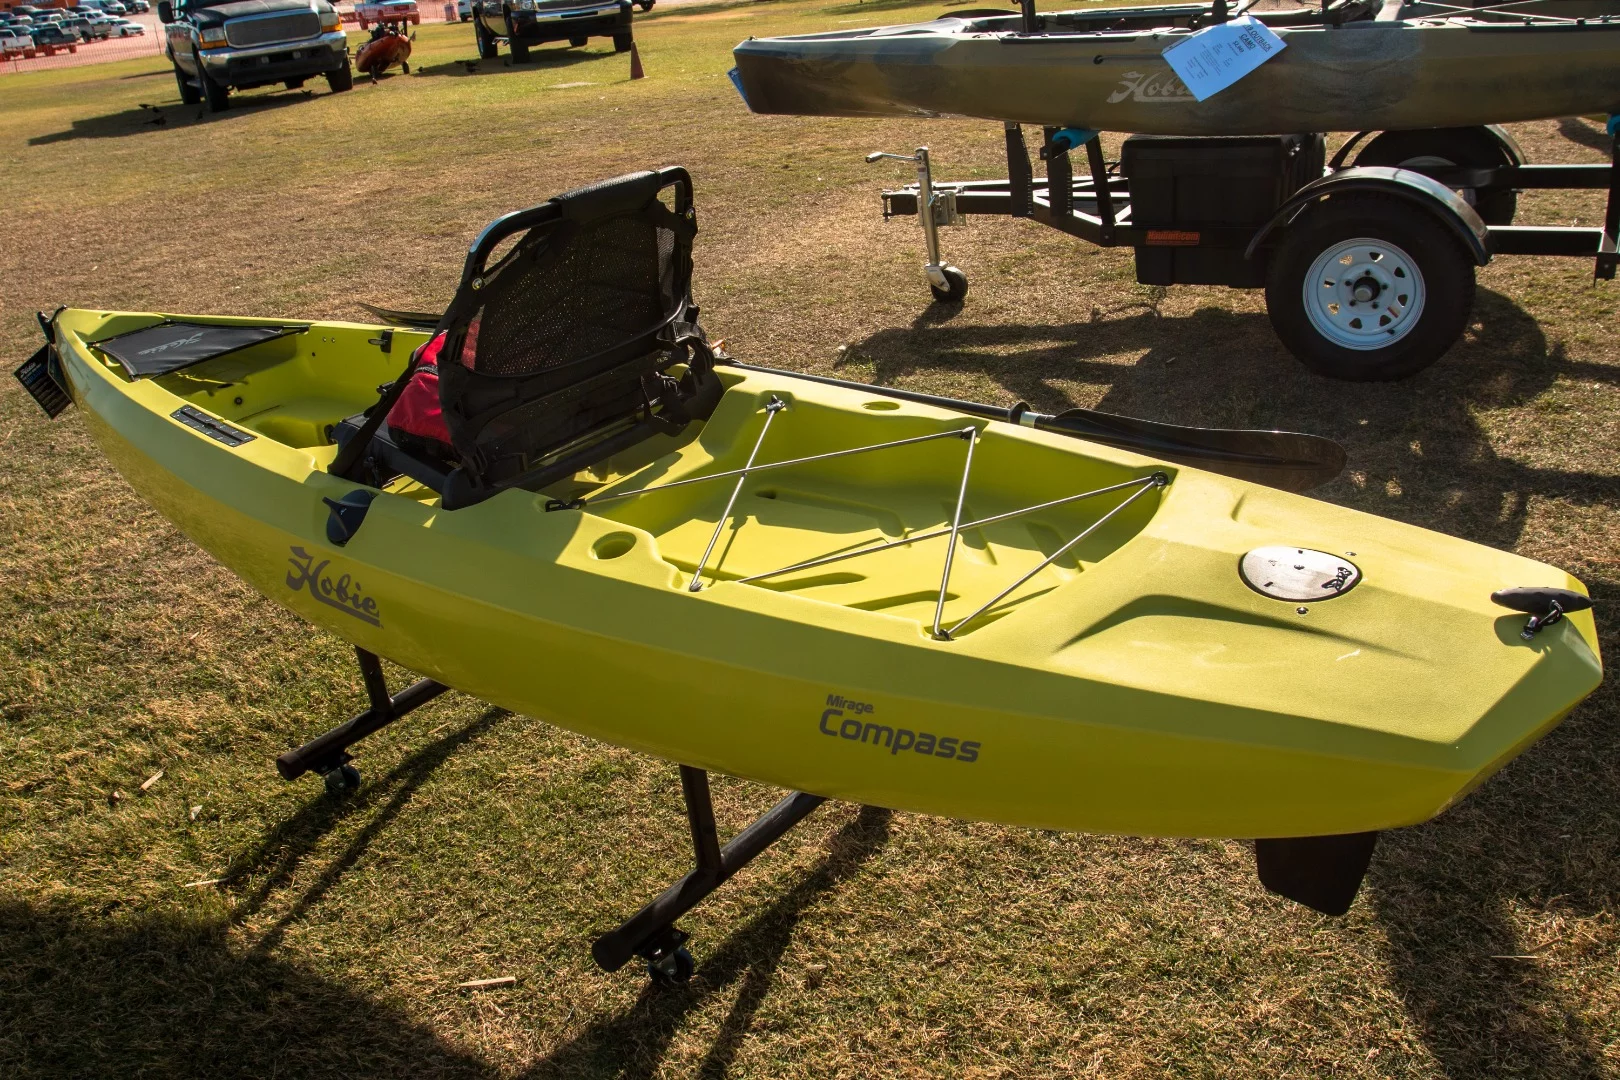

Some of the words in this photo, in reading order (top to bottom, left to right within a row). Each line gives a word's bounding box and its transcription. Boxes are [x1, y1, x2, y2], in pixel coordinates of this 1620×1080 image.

[1239, 34, 1256, 50] CAMO
[1251, 30, 1272, 52] OUTBACK
[285, 545, 381, 628] Hobie
[826, 694, 874, 715] Mirage
[818, 708, 982, 763] Compass
